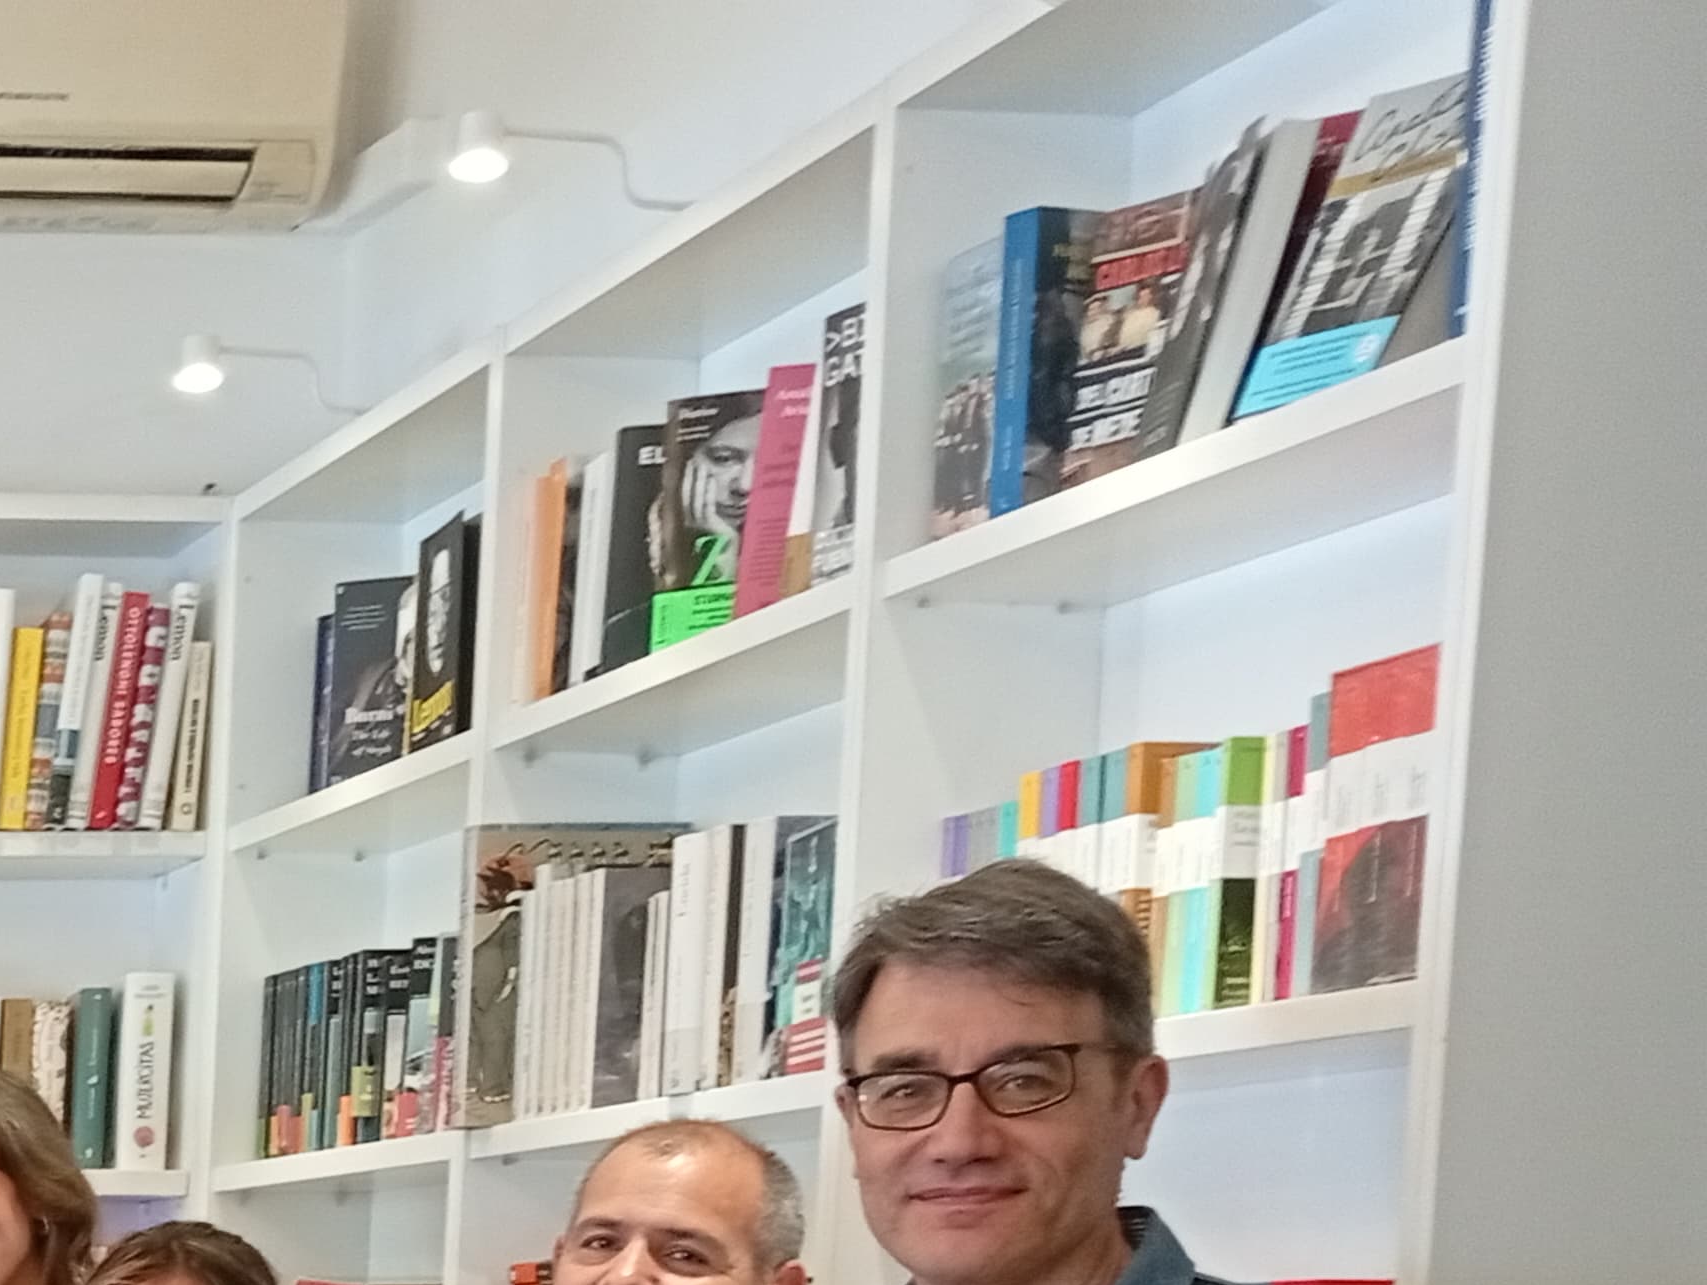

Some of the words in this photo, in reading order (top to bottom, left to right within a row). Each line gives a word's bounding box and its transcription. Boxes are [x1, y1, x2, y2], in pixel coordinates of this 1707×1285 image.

[94, 604, 116, 661] Lemon
[171, 604, 195, 661] Lemon
[136, 1040, 157, 1119] MUJERCITAS
